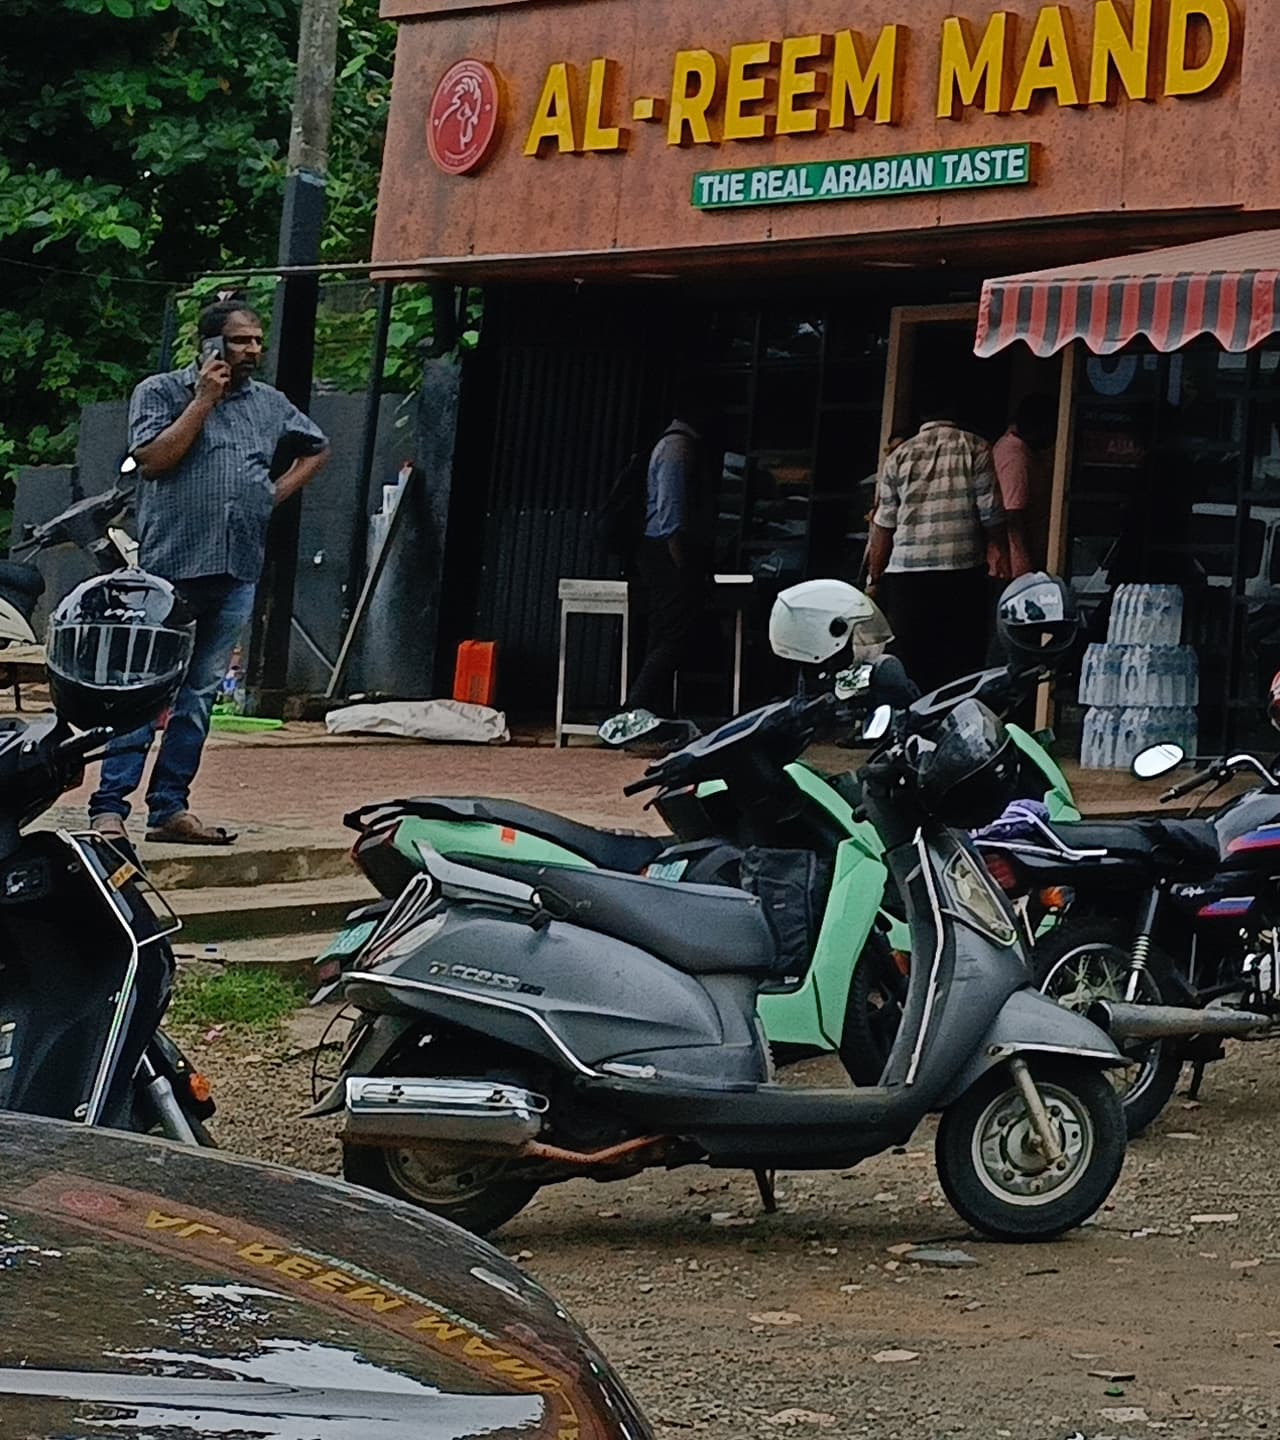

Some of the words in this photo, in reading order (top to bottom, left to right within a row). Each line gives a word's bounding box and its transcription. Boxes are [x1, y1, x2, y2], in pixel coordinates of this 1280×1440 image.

[522, 23, 905, 158] AL-REEM
[698, 174, 743, 205] THE
[749, 167, 813, 201] REAL
[820, 154, 936, 195] ARABIAN
[941, 148, 1026, 187] TASTE
